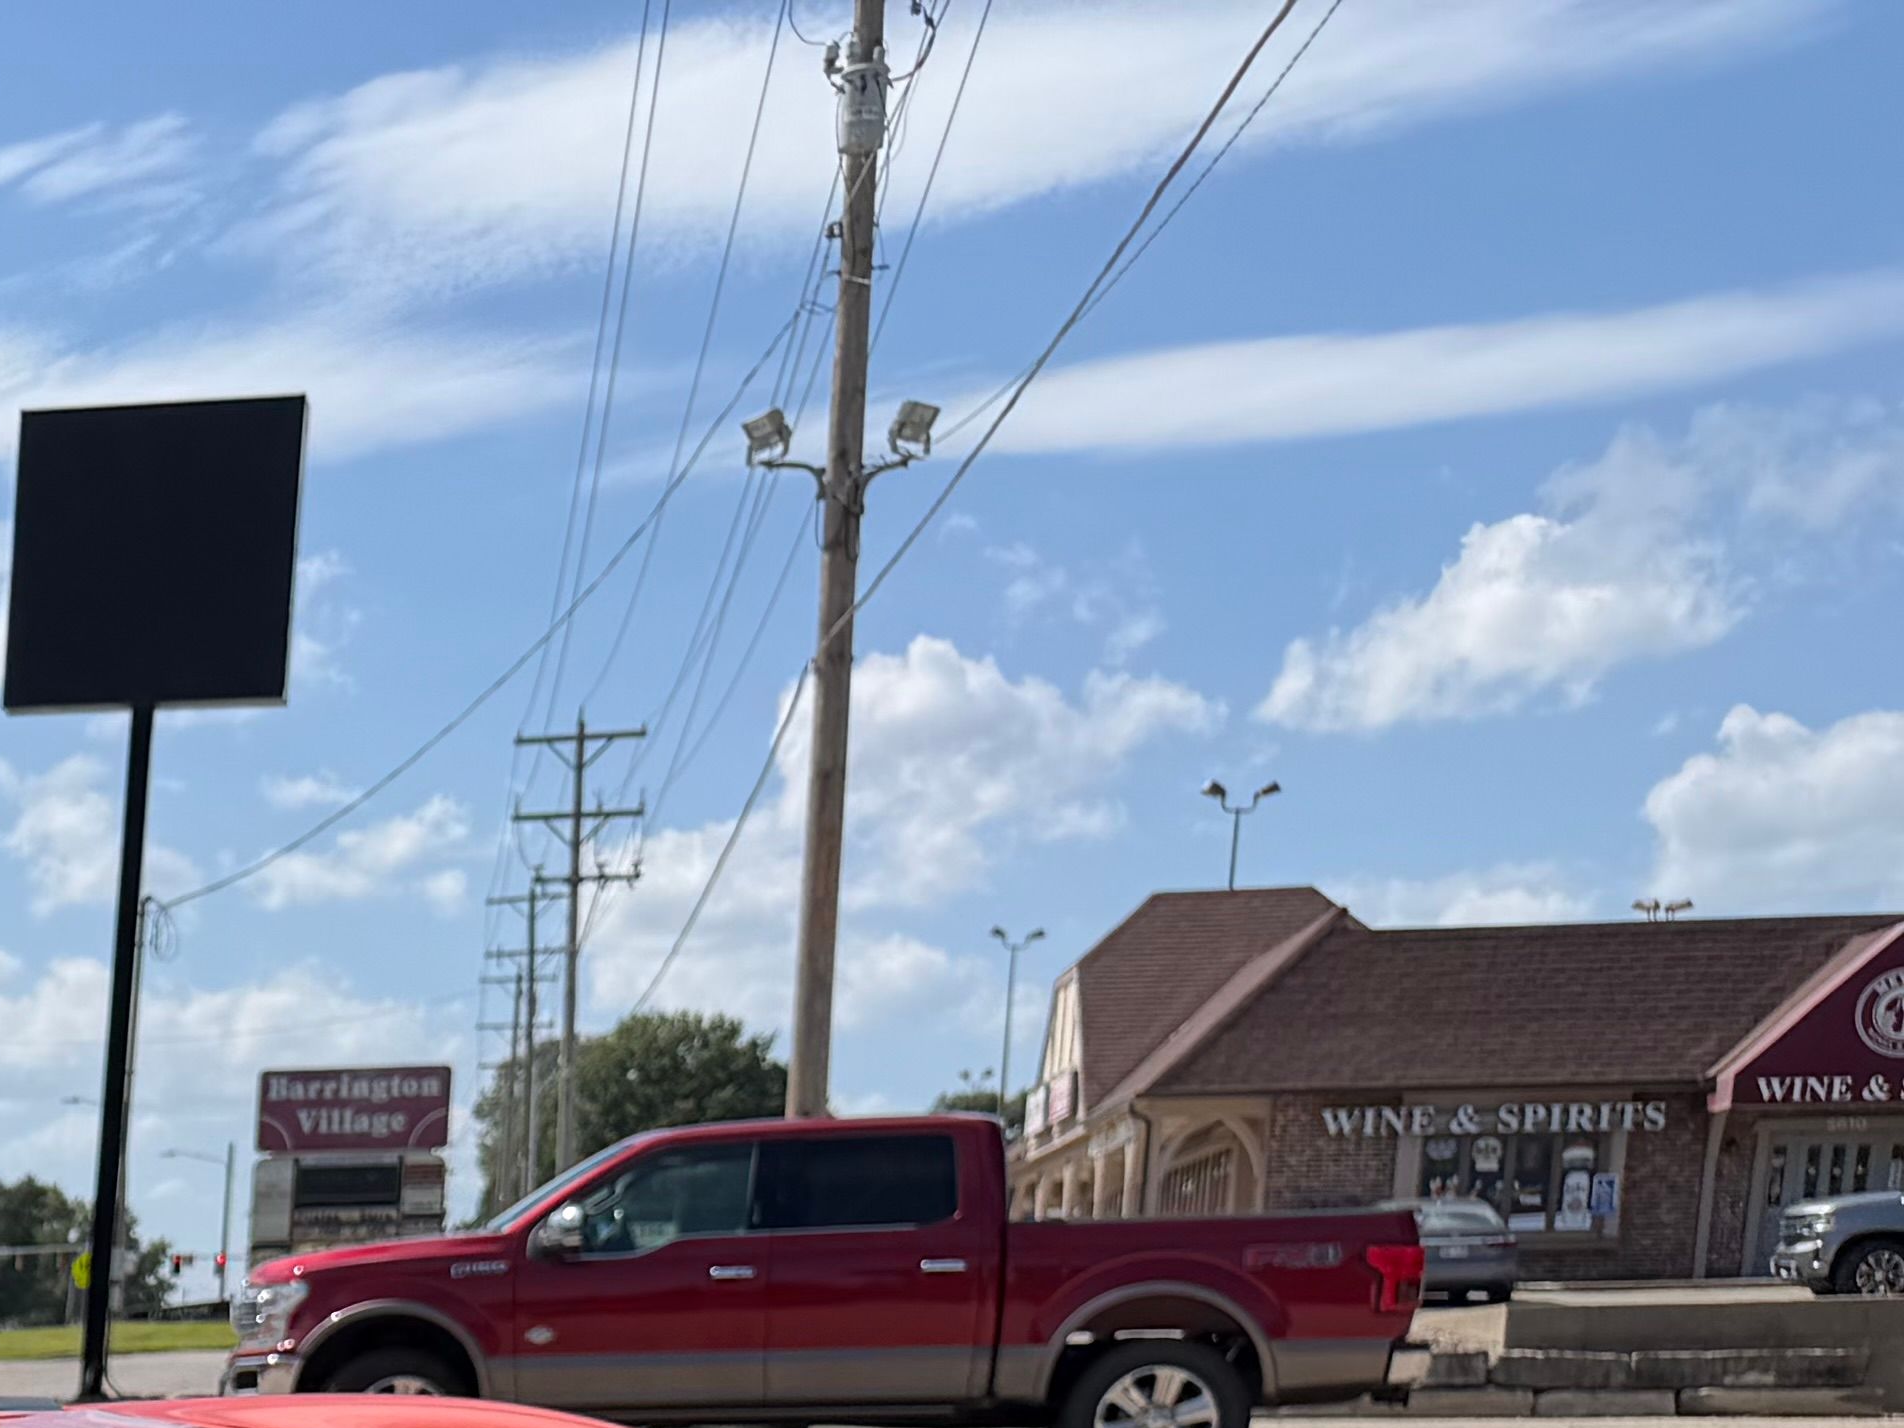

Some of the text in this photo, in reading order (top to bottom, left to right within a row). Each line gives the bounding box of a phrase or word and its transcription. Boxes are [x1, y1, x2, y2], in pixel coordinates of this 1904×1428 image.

[267, 1073, 441, 1104] Barrington
[1757, 1075, 1852, 1102] WINE
[1862, 1074, 1890, 1101] &
[297, 1106, 408, 1138] Village
[1322, 1101, 1666, 1137] WINE & SPIRITS
